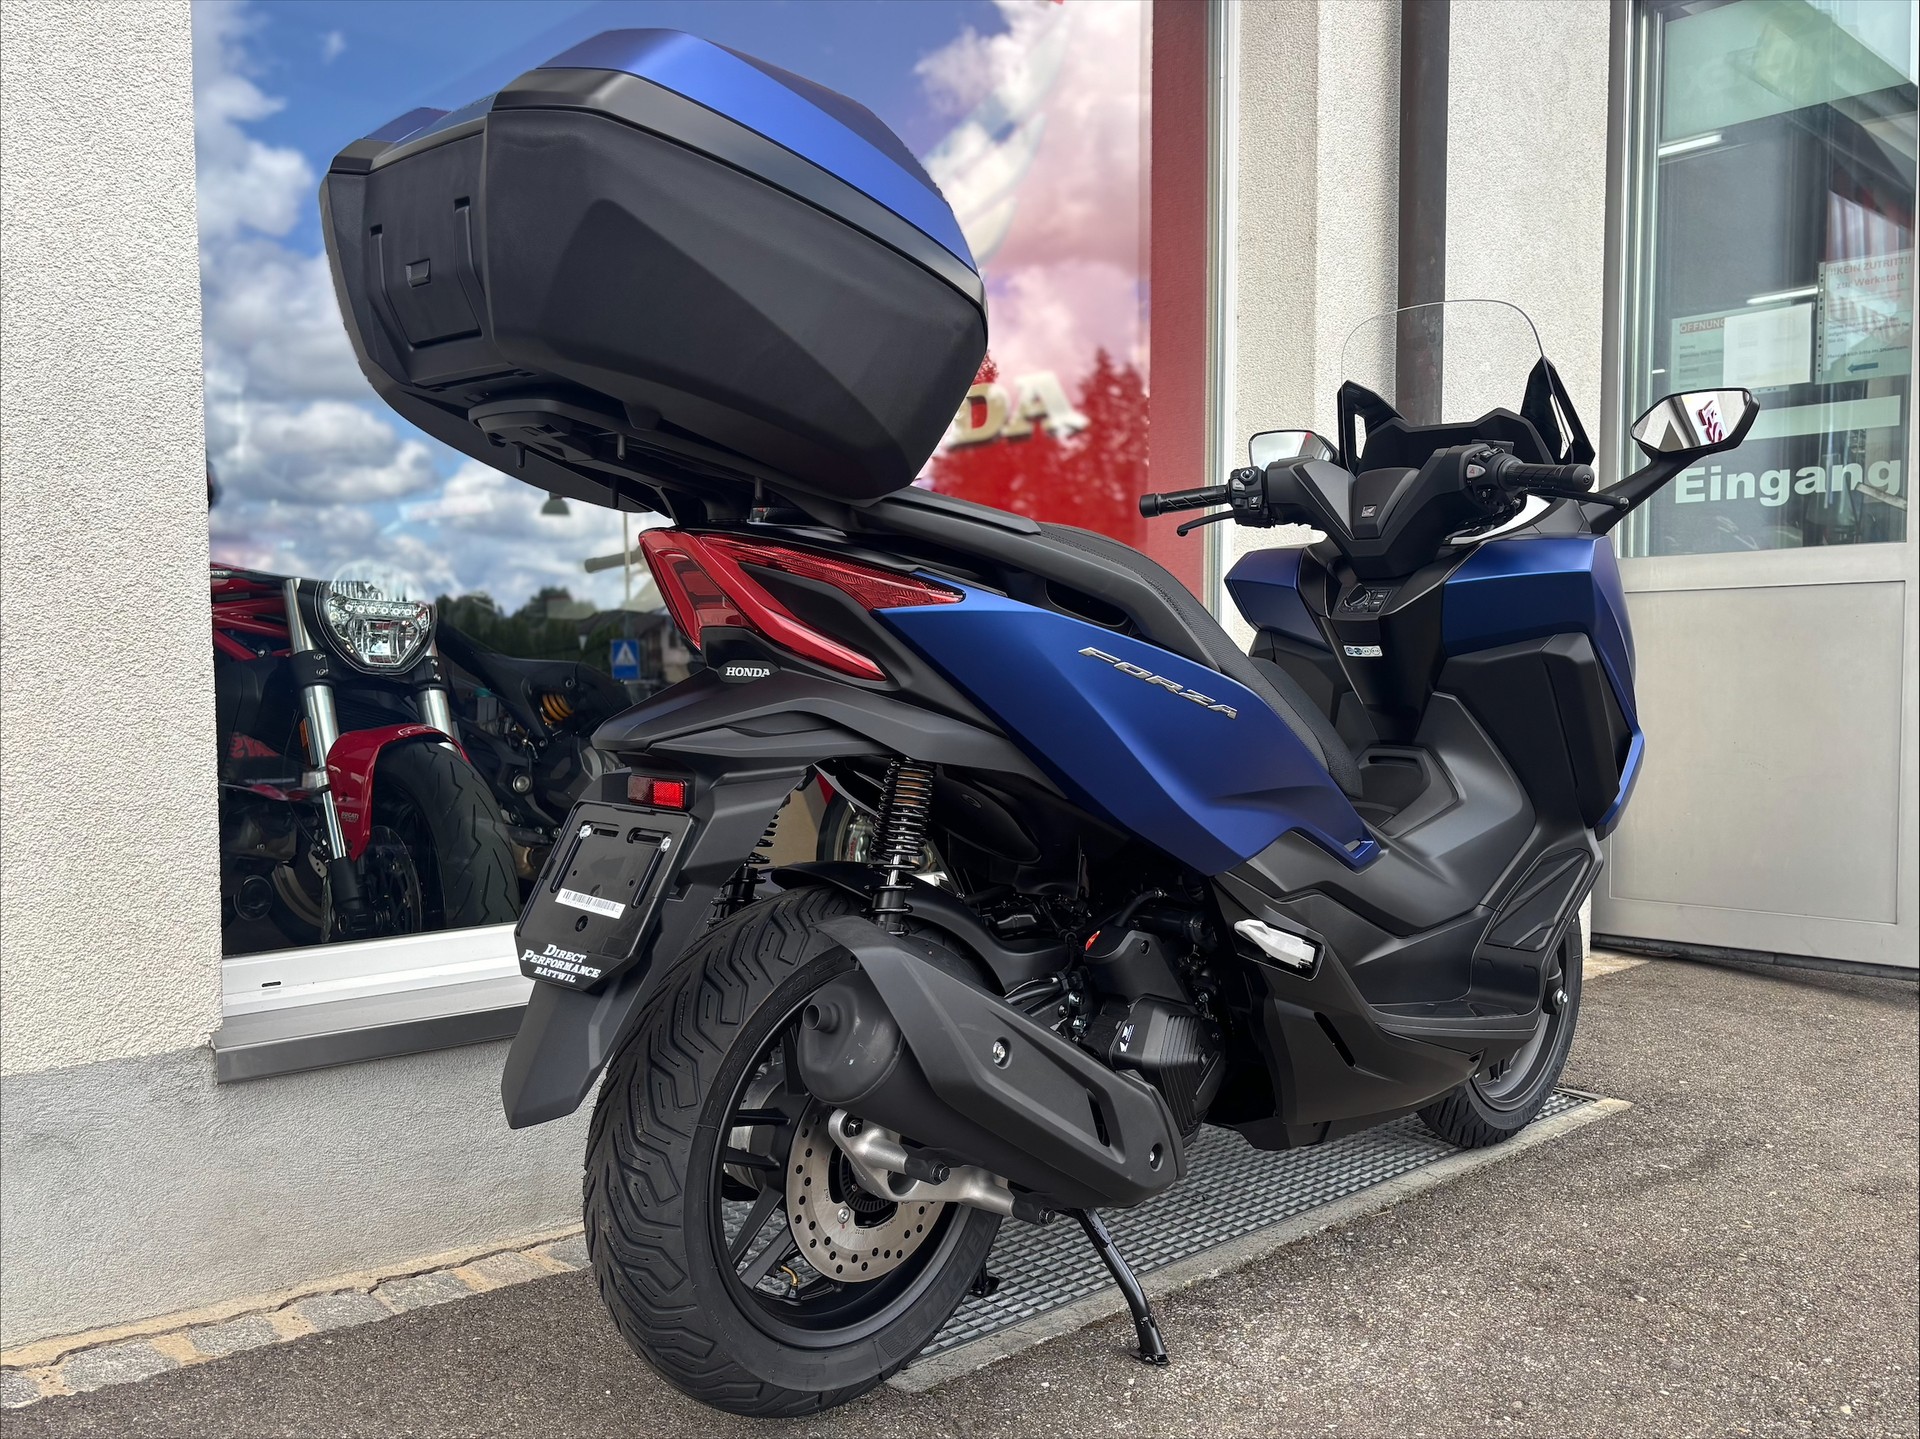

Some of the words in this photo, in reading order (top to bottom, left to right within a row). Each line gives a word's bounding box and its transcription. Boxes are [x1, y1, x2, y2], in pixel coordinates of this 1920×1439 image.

[1854, 272, 1904, 286] Werkstatt
[1675, 459, 1901, 507] Eingang
[725, 666, 770, 677] HONDA
[1078, 647, 1238, 719] FORZA
[543, 943, 587, 963] DIRECT
[520, 949, 601, 978] PERFORMANCE
[534, 966, 576, 983] BATTWIL
